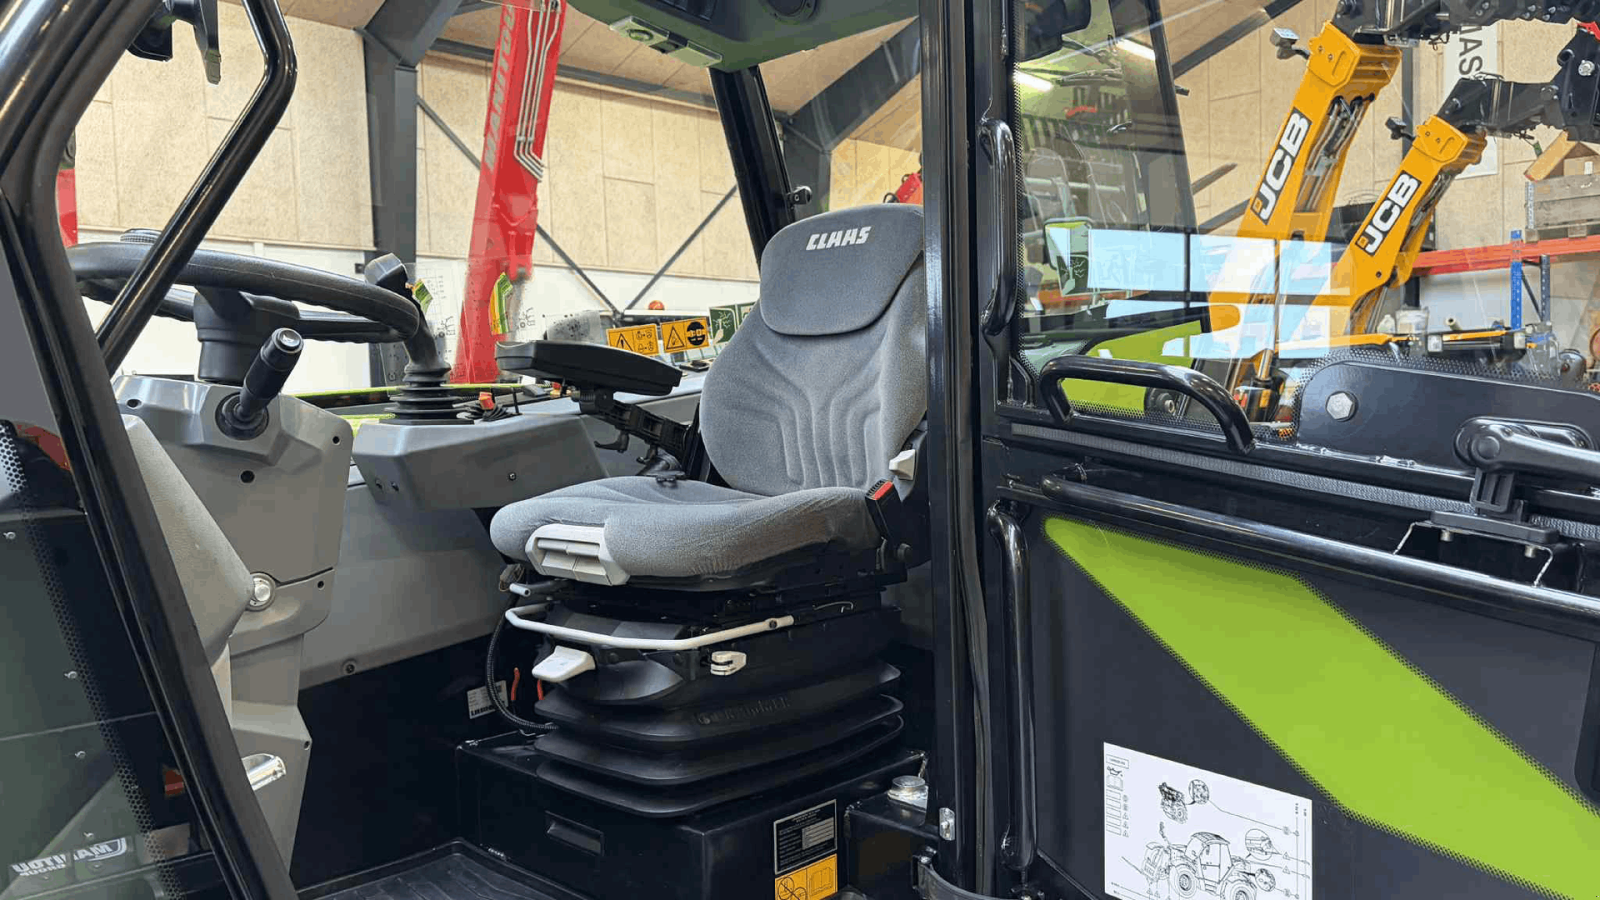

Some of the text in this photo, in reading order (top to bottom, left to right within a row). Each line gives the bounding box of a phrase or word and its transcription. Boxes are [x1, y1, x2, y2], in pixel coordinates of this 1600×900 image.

[1259, 112, 1309, 221] JCB
[805, 226, 872, 251] CLAAS
[1364, 173, 1419, 254] JCB
